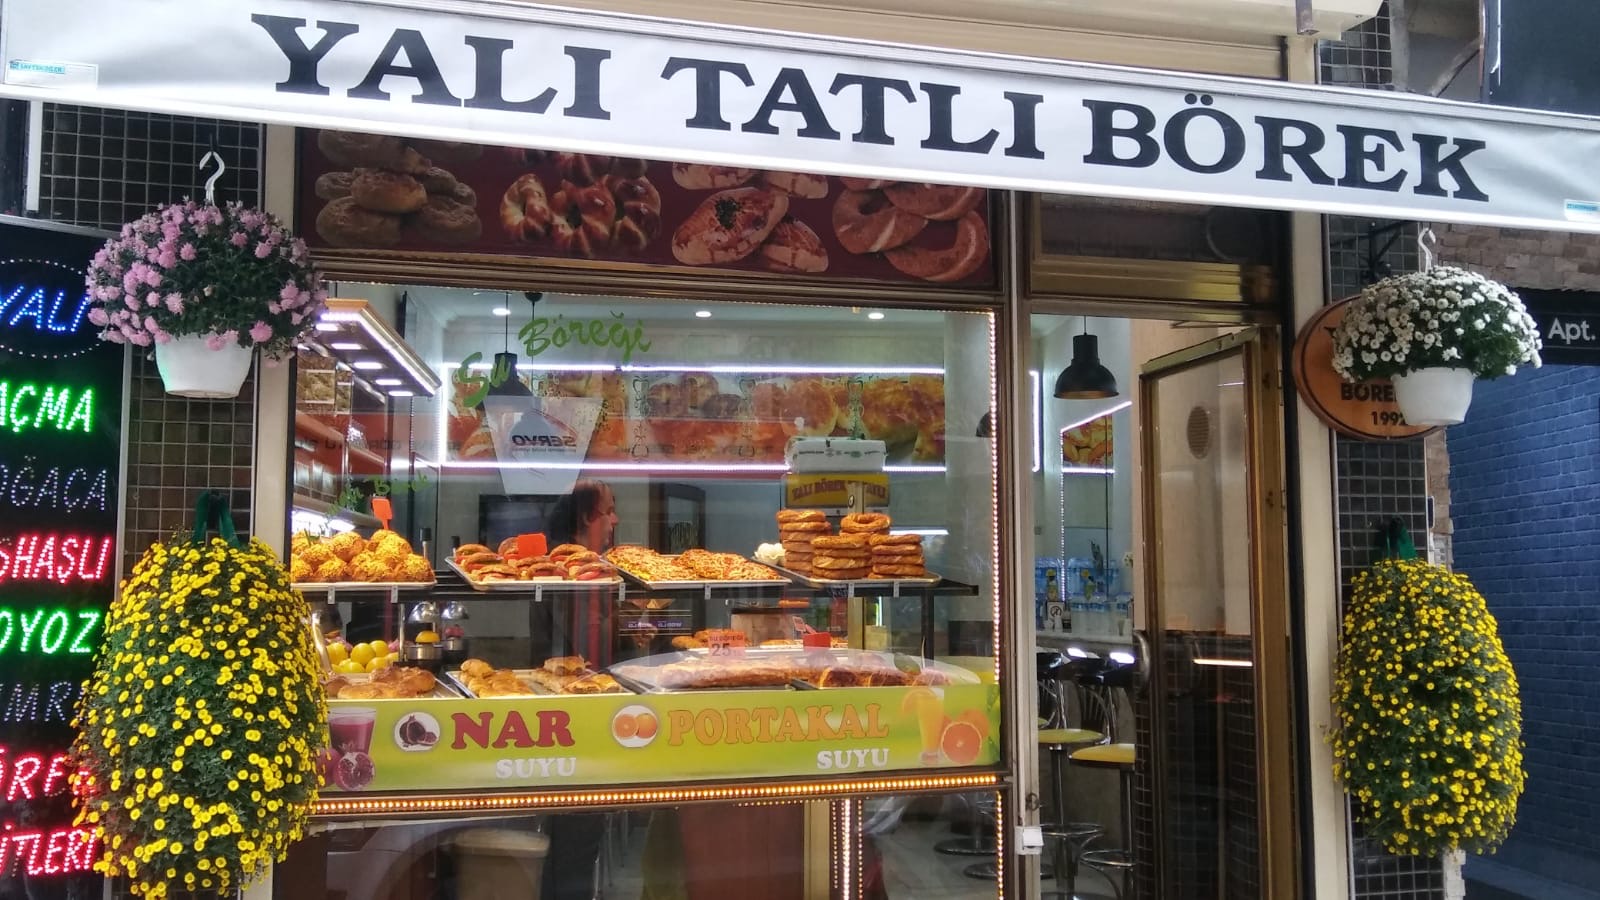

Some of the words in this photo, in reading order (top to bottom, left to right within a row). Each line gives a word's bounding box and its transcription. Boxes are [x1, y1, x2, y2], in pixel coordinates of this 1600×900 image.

[251, 13, 611, 120] YALI
[661, 57, 1046, 160] TATLI
[1083, 93, 1489, 203] BÖREK
[1548, 317, 1596, 344] Apt.
[458, 351, 511, 408] Su
[518, 310, 652, 363] Böreği
[711, 643, 731, 657] 25
[451, 710, 575, 749] NAR
[668, 703, 889, 746] PORTAKAL
[496, 757, 576, 779] SUYU
[817, 748, 889, 770] SUYU
